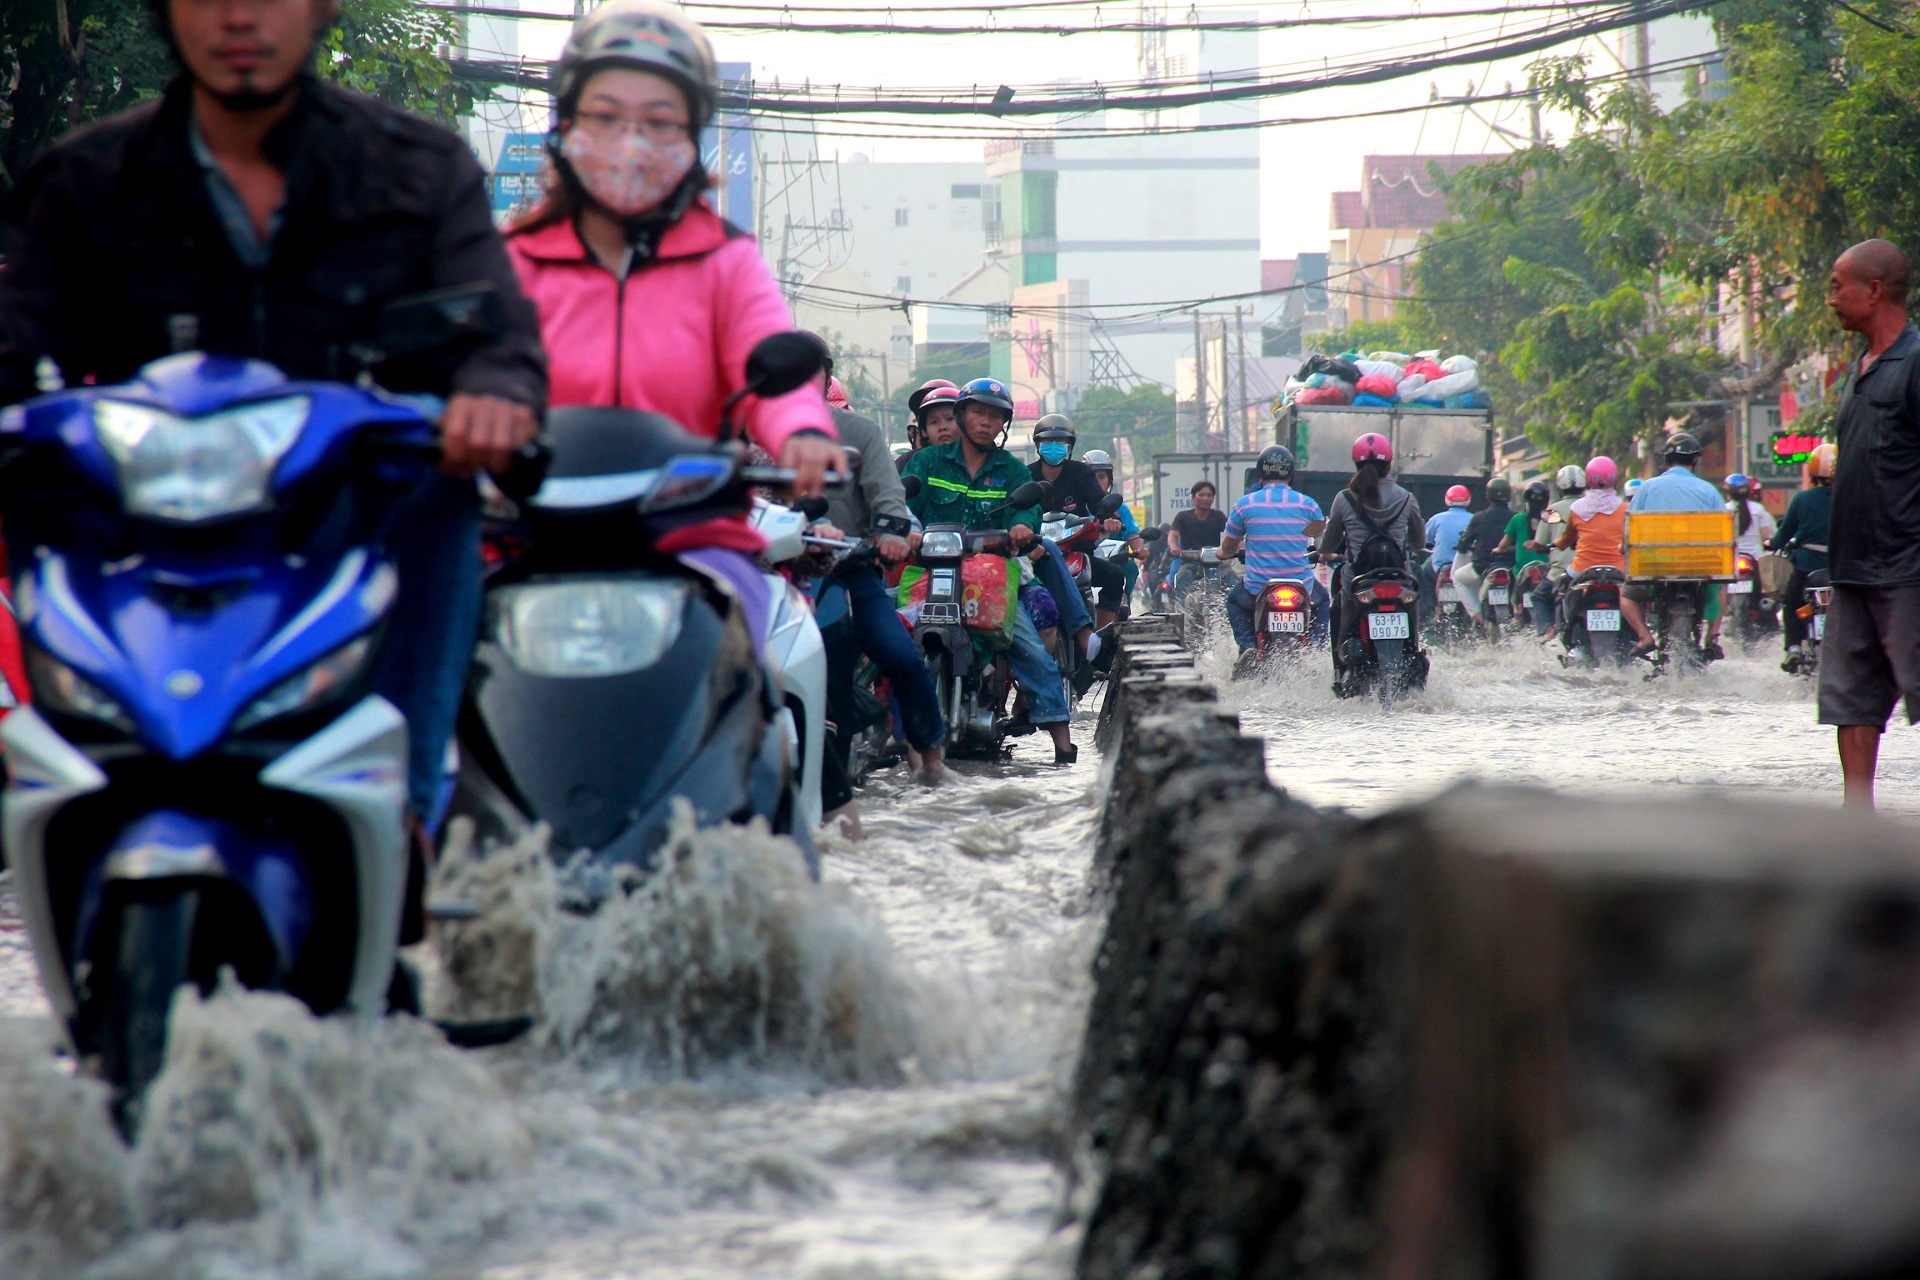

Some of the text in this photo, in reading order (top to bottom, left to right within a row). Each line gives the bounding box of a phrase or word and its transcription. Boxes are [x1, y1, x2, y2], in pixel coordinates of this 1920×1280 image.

[1273, 612, 1299, 622] 61-F1
[1375, 614, 1401, 626] 63-P1
[1592, 611, 1615, 620] 59-C2
[1271, 622, 1302, 632] 109.30
[1590, 620, 1618, 630] 761.12
[1372, 626, 1407, 638] 090.76
